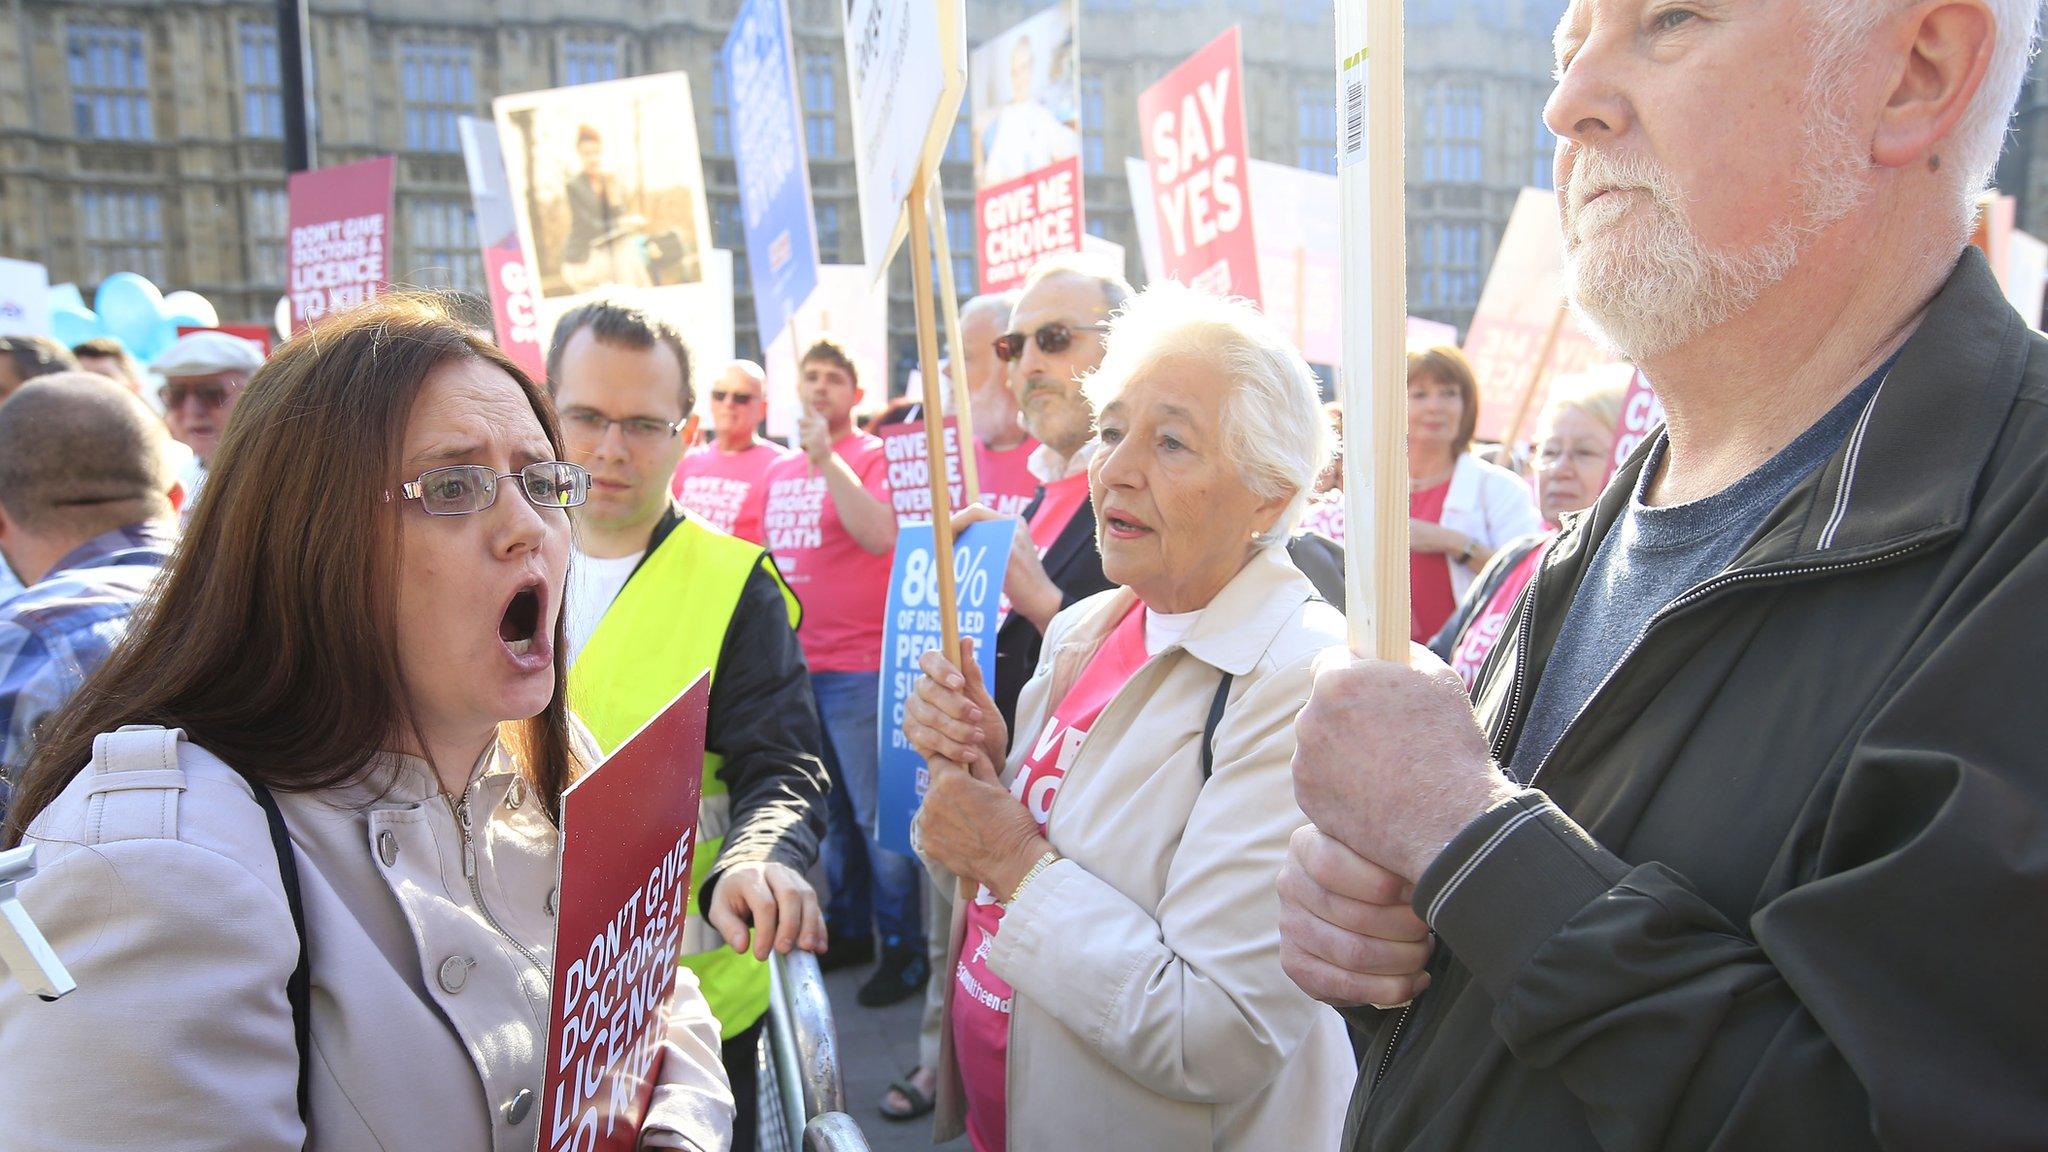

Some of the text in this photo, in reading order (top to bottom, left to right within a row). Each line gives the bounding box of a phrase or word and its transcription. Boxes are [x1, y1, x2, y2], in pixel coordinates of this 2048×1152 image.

[1153, 68, 1231, 184] SAY
[983, 169, 1073, 232] GIVE ME
[1158, 154, 1243, 257] YES
[291, 213, 384, 247] DON'T GIVE
[985, 206, 1074, 266] CHOICE
[291, 236, 384, 268] DOCTORS A
[291, 255, 384, 293] LICENCE
[290, 290, 327, 321] TO
[885, 431, 928, 462] GIVE
[722, 479, 752, 496] ME
[888, 455, 962, 490] CHOE
[892, 488, 932, 513] OVER
[797, 511, 823, 529] MY
[897, 610, 916, 631] OF
[916, 611, 984, 634] DISLED
[563, 827, 690, 1020] DON'T GIVE
[559, 881, 683, 1074] DOCTORS A
[550, 924, 679, 1150] LICENCE
